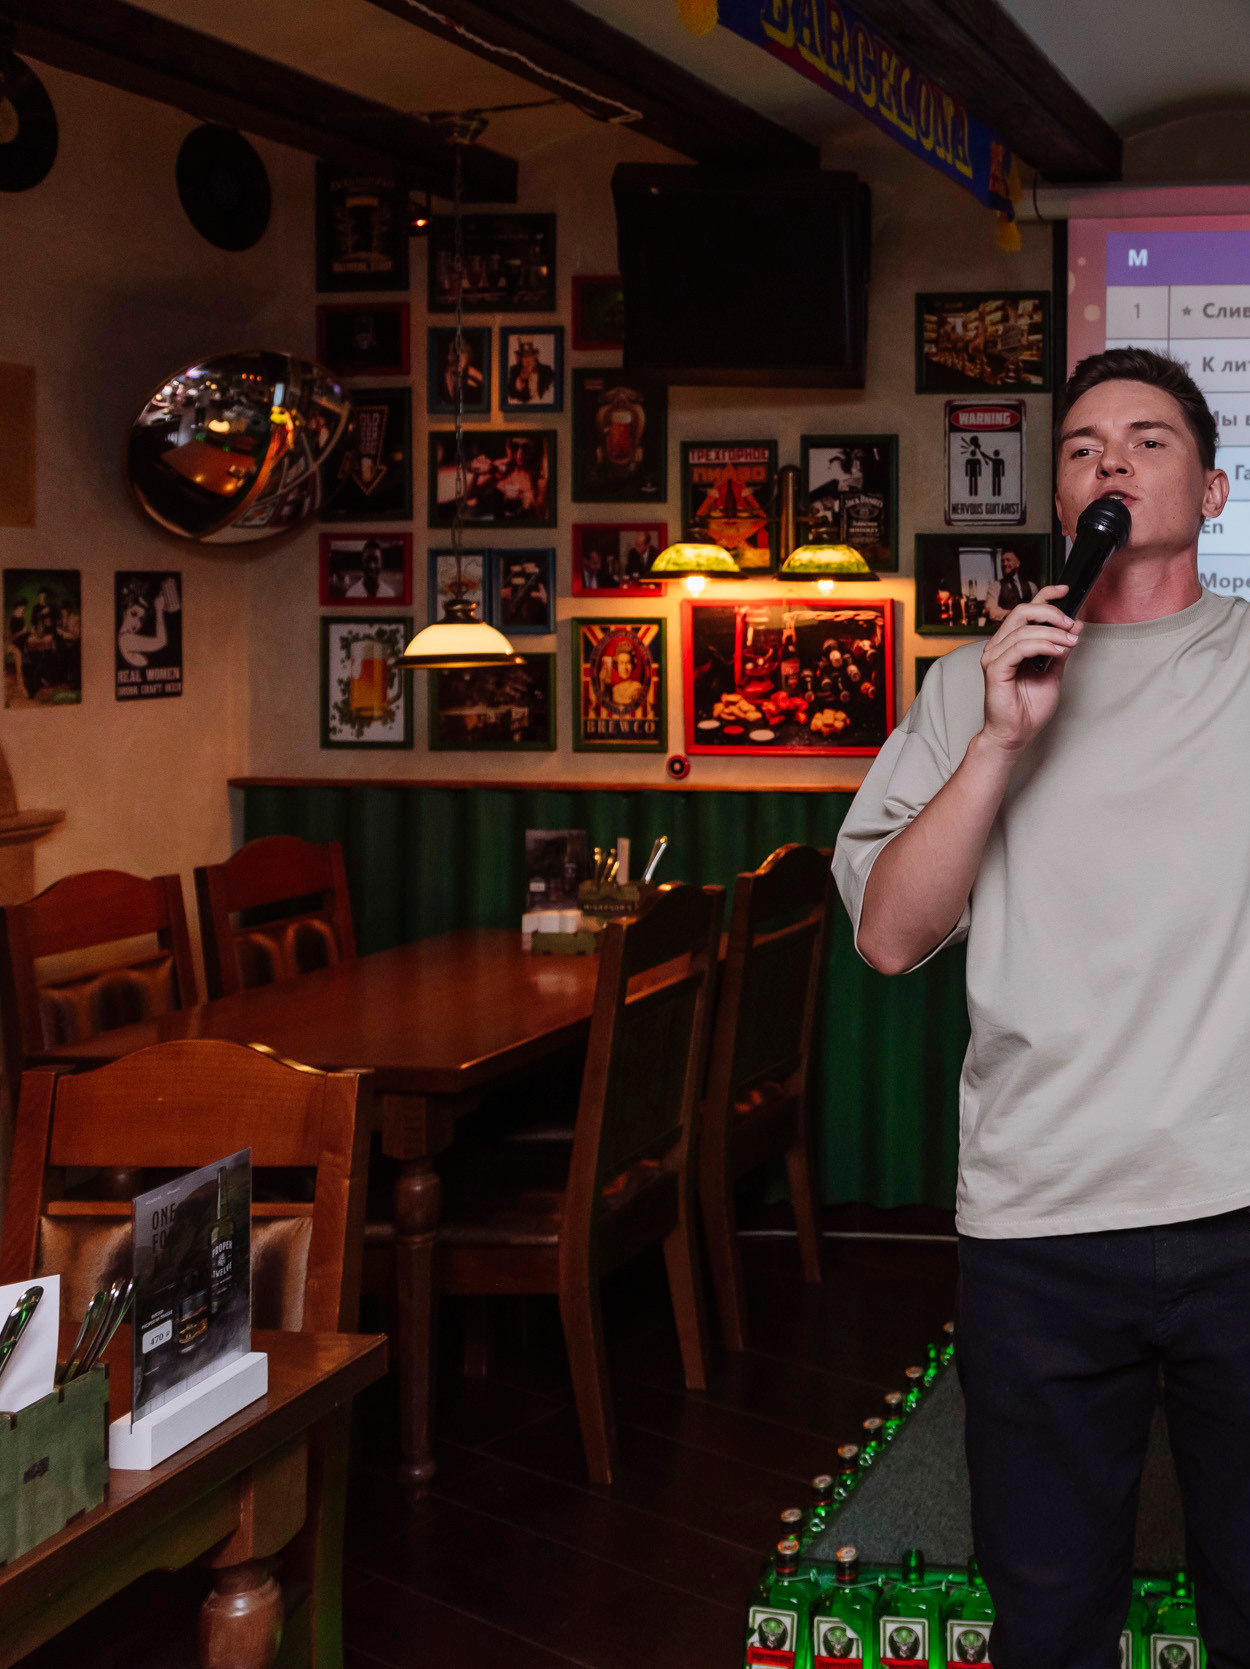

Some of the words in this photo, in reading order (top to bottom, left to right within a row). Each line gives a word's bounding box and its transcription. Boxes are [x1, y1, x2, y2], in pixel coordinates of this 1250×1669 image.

[1128, 248, 1148, 267] М
[1133, 302, 1142, 319] 1
[1202, 356, 1215, 372] К
[958, 412, 1011, 425] WARNING
[689, 448, 768, 462] ТРЕХГОРНОЕ
[951, 503, 983, 515] NERVOUS
[985, 502, 1019, 515] GUITARIST
[117, 669, 142, 684] REAL
[145, 667, 180, 681] WOMEN
[586, 719, 656, 734] BREWCO
[152, 1202, 177, 1231] ONE
[211, 1240, 232, 1258] PROPER
[211, 1260, 232, 1279] TWELVE
[150, 1333, 164, 1346] 470
